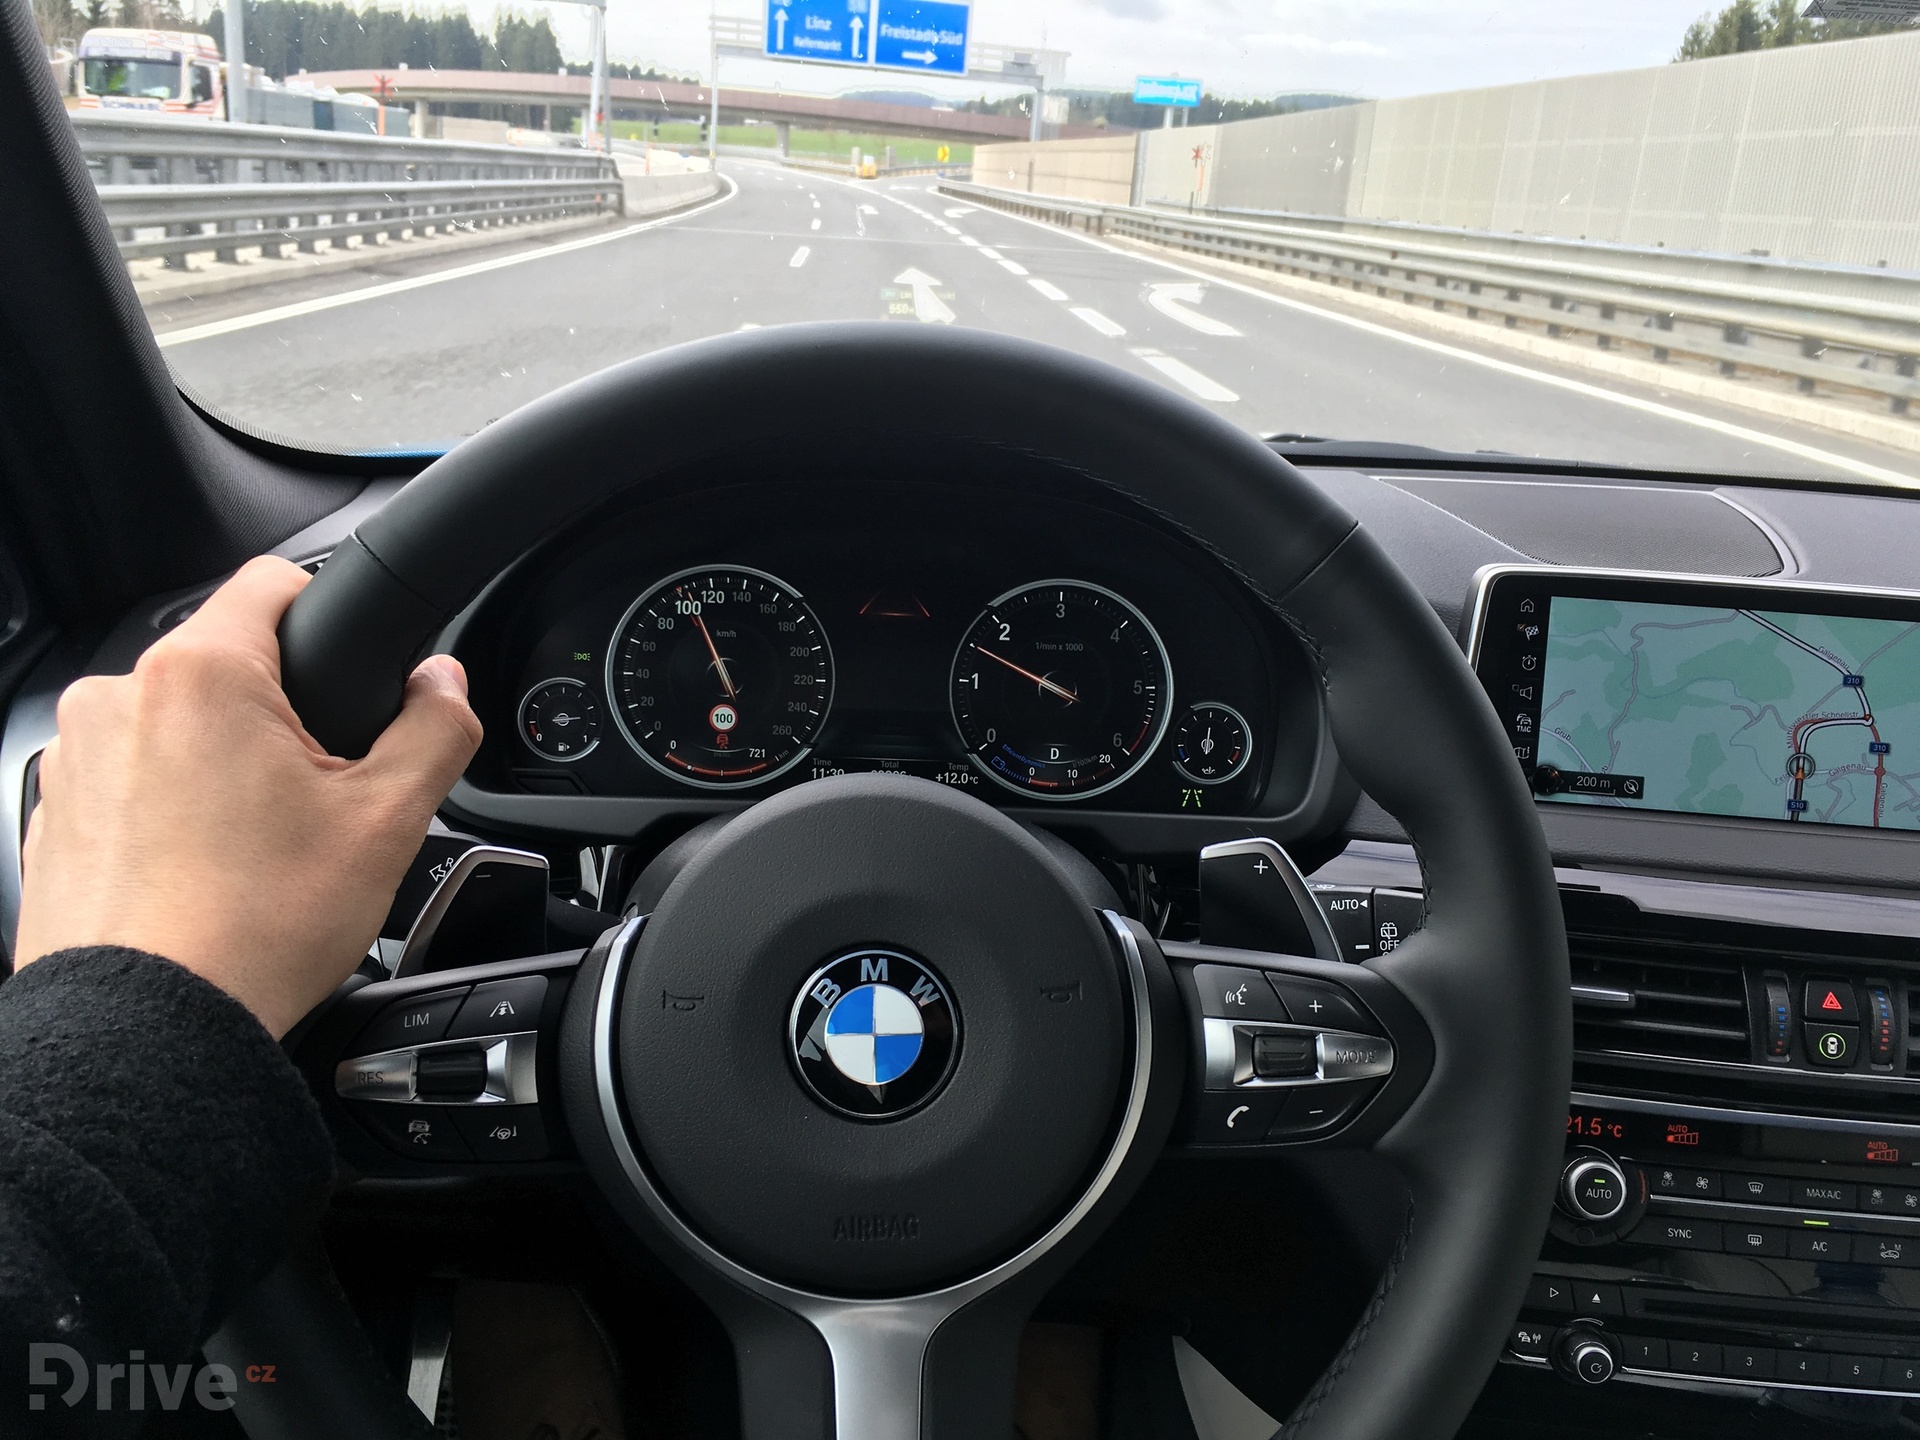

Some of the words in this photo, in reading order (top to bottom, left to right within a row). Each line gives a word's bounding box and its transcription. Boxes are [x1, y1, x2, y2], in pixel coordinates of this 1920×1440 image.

[805, 15, 832, 31] Linz
[700, 590, 725, 604] 120
[732, 592, 752, 603] 140
[675, 600, 702, 615] 100
[759, 604, 777, 614] 160
[1056, 604, 1065, 618] 3
[657, 618, 674, 630] 80
[778, 622, 796, 632] 180
[716, 630, 737, 638] km/h
[999, 624, 1010, 641] 2
[1110, 629, 1120, 642] 4
[642, 641, 656, 651] 60
[790, 646, 809, 657] 200
[1035, 642, 1057, 651] 1/min
[1065, 643, 1083, 651] 1000
[636, 669, 649, 679] 40
[794, 675, 814, 685] 220
[971, 672, 979, 689] 1
[1133, 681, 1143, 694] 5
[641, 696, 654, 706] 20
[788, 702, 807, 713] 240
[715, 713, 733, 723] 100
[654, 721, 662, 731] 0
[772, 725, 792, 735] 260
[1516, 725, 1531, 733] TMC
[536, 733, 542, 742] 0
[583, 735, 588, 743] 1
[987, 728, 996, 743] 0
[1554, 727, 1572, 741] Grub
[670, 740, 677, 749] 0
[1113, 733, 1122, 747] 6
[749, 748, 766, 758] 721
[1050, 747, 1060, 760] D
[1873, 744, 1886, 752] 310
[812, 758, 832, 766] Time
[881, 760, 899, 768] Total
[1099, 754, 1111, 764] 20
[947, 763, 969, 772] Temp
[1029, 767, 1036, 776] 0
[1828, 763, 1867, 777] Galgenau
[1067, 769, 1078, 779] 10
[1576, 776, 1597, 788] 200
[1600, 779, 1611, 788] m
[445, 857, 454, 868] R
[1330, 899, 1359, 911] AUTO
[1379, 940, 1400, 951] OFF
[810, 957, 940, 1009] BMW
[404, 1013, 430, 1028] LIM
[1336, 1050, 1376, 1064] MODE
[357, 1071, 384, 1085] RES
[1566, 1115, 1602, 1136] 21.5
[1667, 1124, 1688, 1133] AUTO
[1867, 1141, 1888, 1150] AUTO
[1586, 1188, 1612, 1199] AUTO
[833, 1215, 921, 1241] AIRBAG
[1668, 1228, 1692, 1239] SYNC
[1812, 1241, 1828, 1252] A/C
[1643, 1346, 1649, 1356] 1
[1692, 1352, 1699, 1362] 2
[1746, 1357, 1753, 1367] 3
[1799, 1361, 1806, 1371] 4
[1853, 1365, 1860, 1375] 5
[1907, 1369, 1913, 1380] 6
